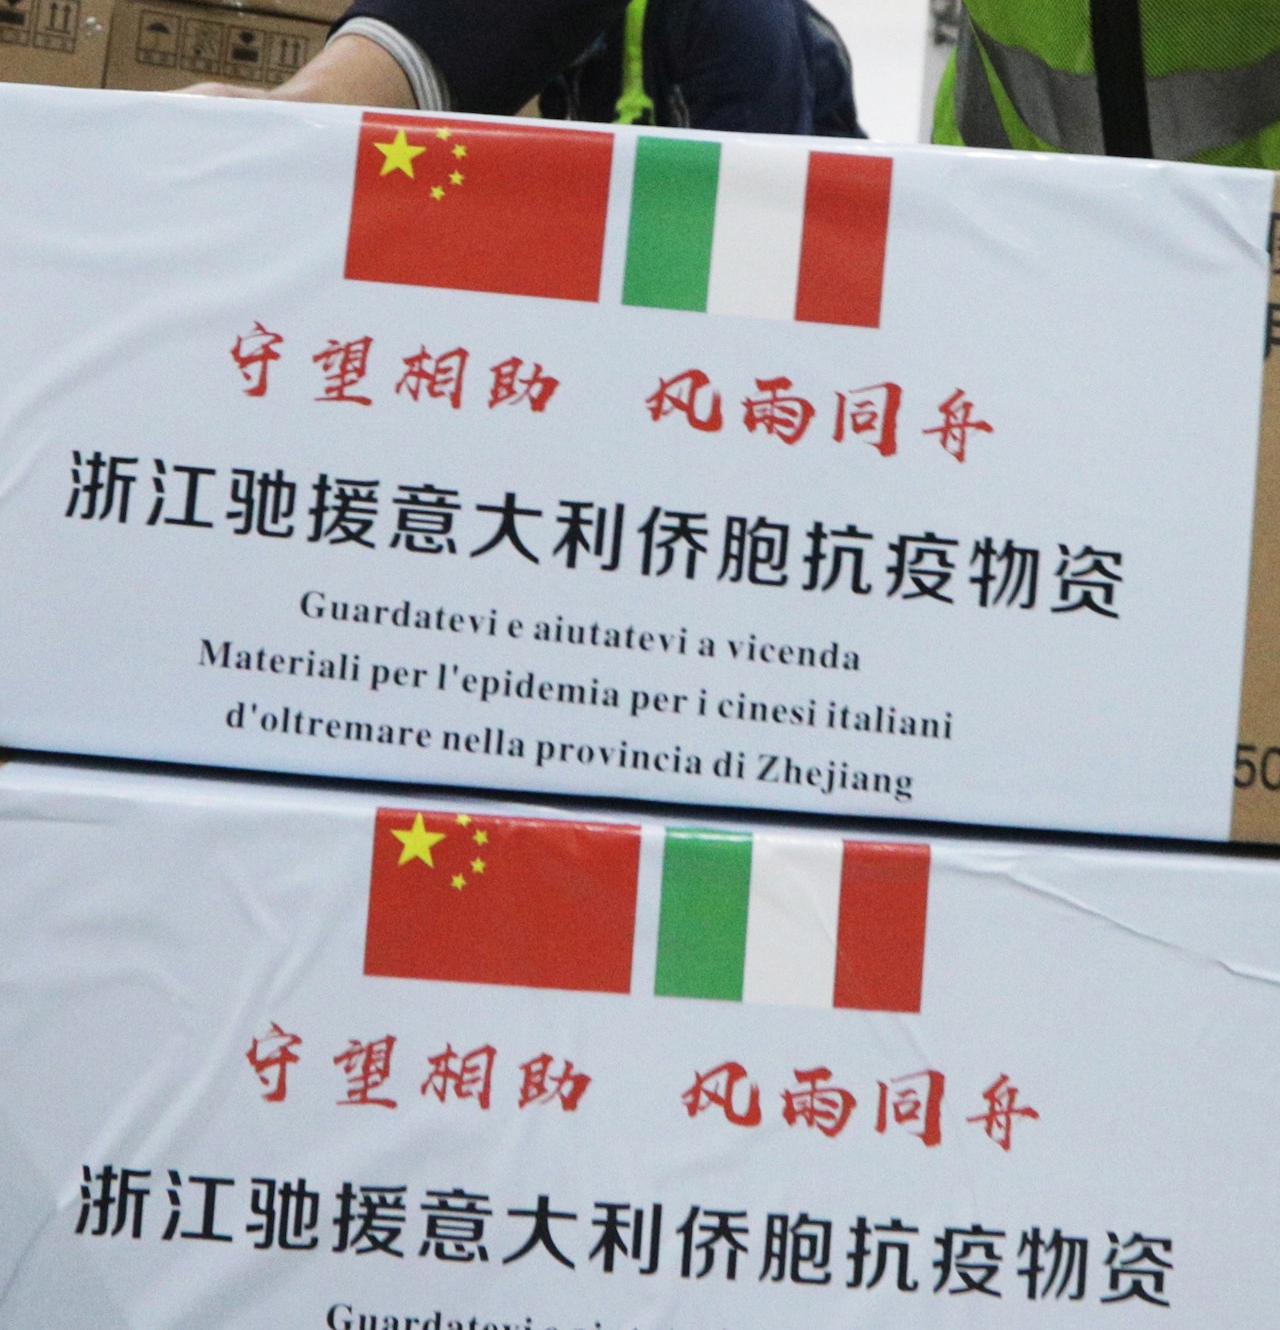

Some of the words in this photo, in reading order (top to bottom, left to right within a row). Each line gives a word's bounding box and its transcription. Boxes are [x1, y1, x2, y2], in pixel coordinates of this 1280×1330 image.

[230, 321, 561, 413] 守望相助
[646, 367, 995, 463] 风雨同舟
[64, 449, 1124, 620] 浙江驰援意大利侨胞抗疫物资
[200, 637, 360, 682] Materiali
[370, 663, 428, 691] per
[438, 663, 619, 709] l'epidemia
[630, 689, 688, 717] per
[698, 696, 707, 717] i
[717, 700, 816, 728] cinesi
[827, 705, 953, 740] italiani
[300, 591, 497, 636] Guardatevi
[507, 619, 524, 639] e
[533, 620, 686, 655] aiutatevi
[698, 638, 715, 658] a
[727, 639, 861, 672] vicenda
[225, 700, 432, 748] d'oltremare
[442, 726, 525, 758] nella
[535, 739, 703, 775] provincia
[712, 750, 746, 779] di
[757, 755, 913, 802] Zhejiang
[246, 1022, 592, 1112] 守望相助
[682, 1060, 1040, 1152] 风雨同舟
[74, 1163, 1175, 1309] 浙江驰援意大利侨胞抗疫物资
